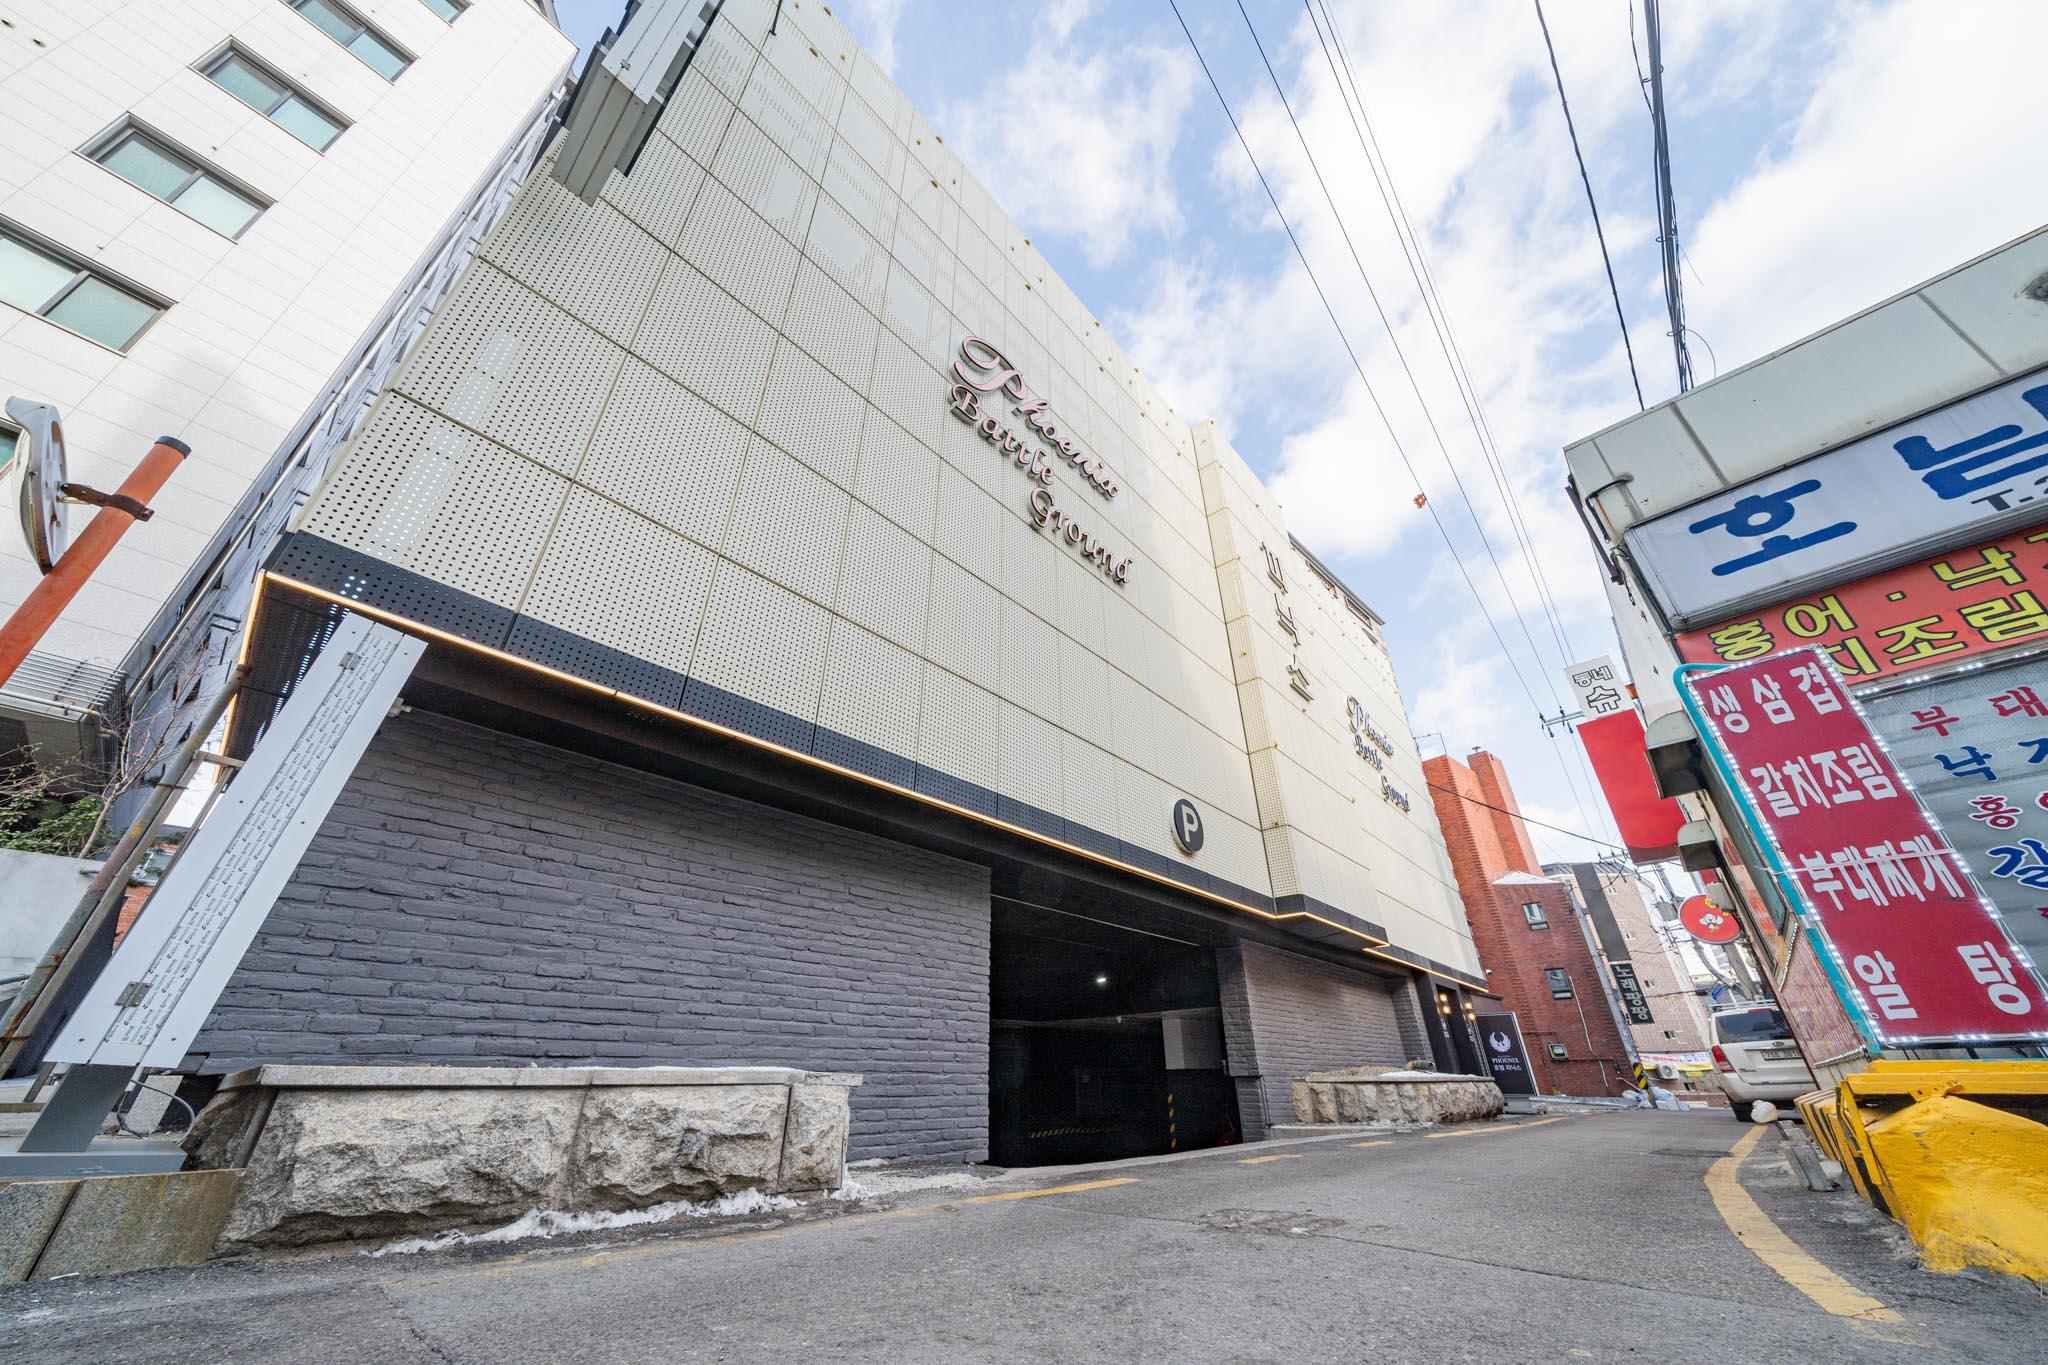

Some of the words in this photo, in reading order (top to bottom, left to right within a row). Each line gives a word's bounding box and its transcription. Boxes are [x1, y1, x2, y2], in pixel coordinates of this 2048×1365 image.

[951, 383, 1054, 487] Battle
[953, 336, 1120, 498] Phoenix
[1029, 486, 1134, 585] Ground
[1572, 665, 1614, 688] 동네
[1750, 742, 1898, 819] 갈치조림
[1800, 833, 1966, 912] 부대찌개
